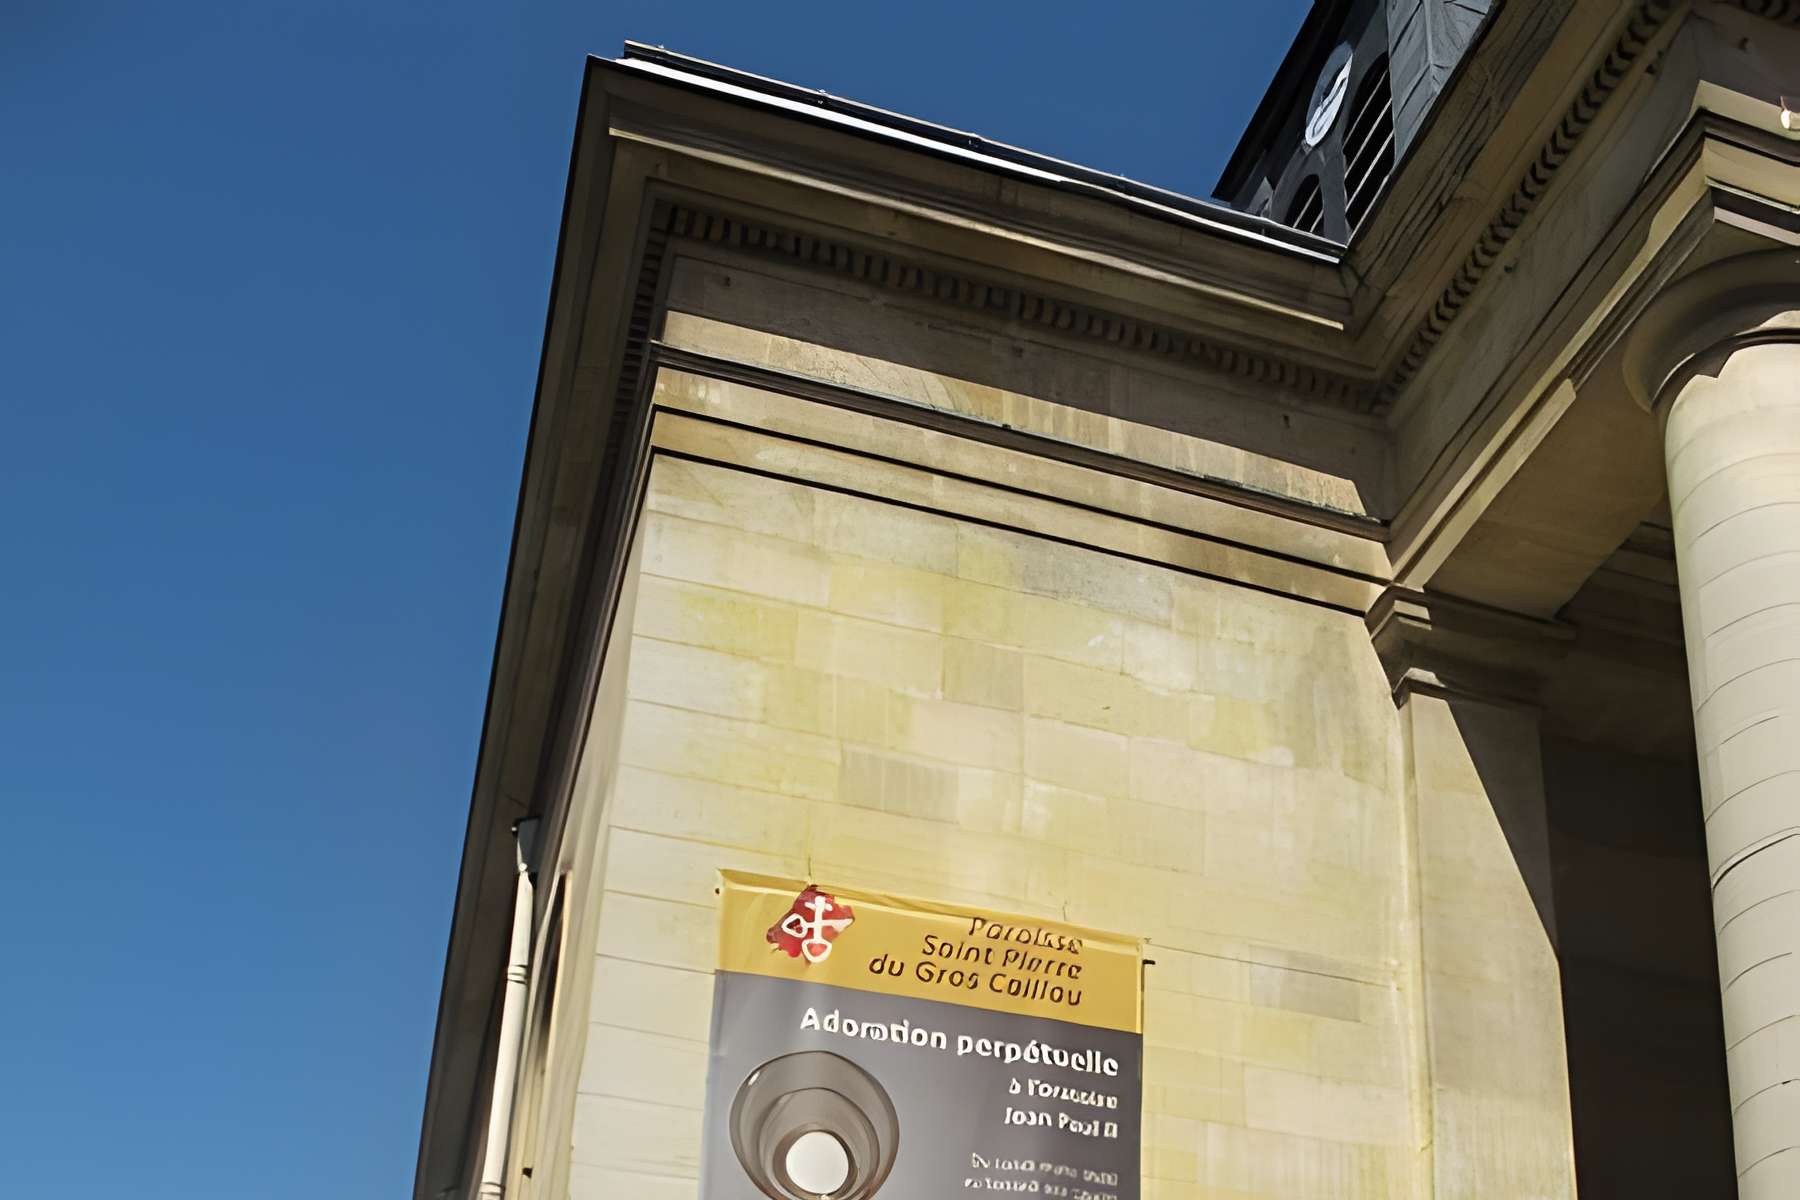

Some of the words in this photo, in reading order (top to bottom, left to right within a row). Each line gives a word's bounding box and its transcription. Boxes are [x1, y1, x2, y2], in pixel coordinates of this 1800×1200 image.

[921, 934, 992, 965] Saint
[868, 953, 905, 977] du
[915, 960, 979, 990] Gros
[989, 972, 1082, 1006] Caillou
[800, 1007, 947, 1050] Adoration
